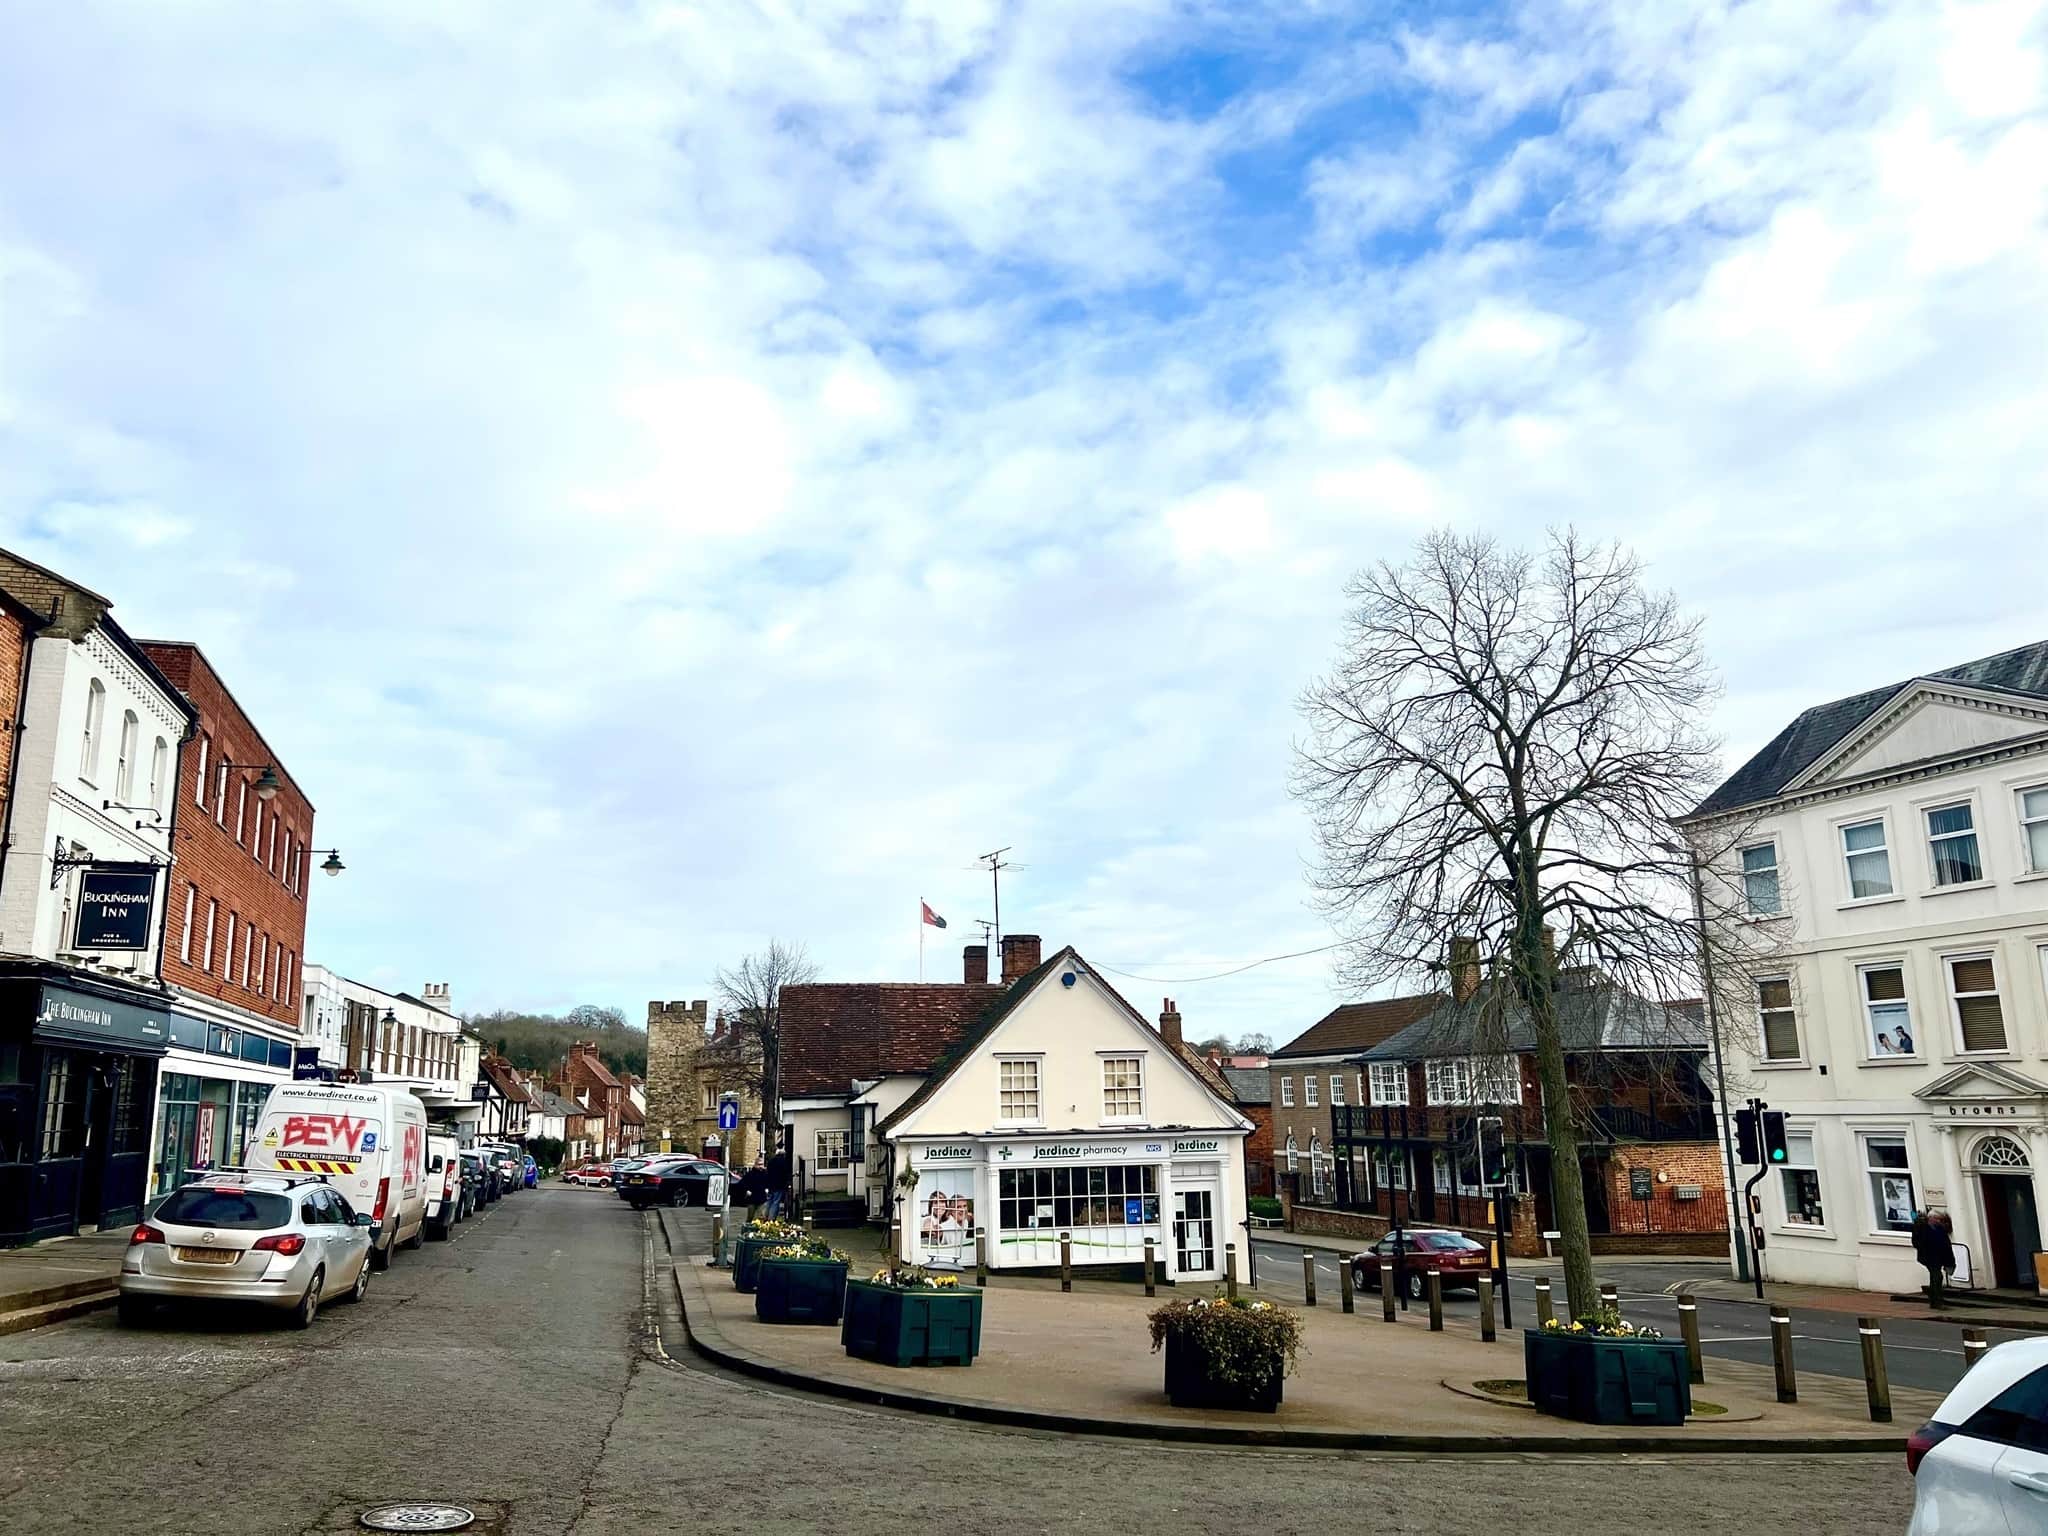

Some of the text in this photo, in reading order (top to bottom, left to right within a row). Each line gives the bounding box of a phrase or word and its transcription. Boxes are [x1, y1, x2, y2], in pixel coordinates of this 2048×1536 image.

[84, 891, 149, 904] BUCKINGHAM
[102, 905, 128, 918] INN
[61, 1002, 100, 1025] BUCKINGHAM
[282, 1088, 378, 1103] www.bewdirect.co.uk
[1949, 1105, 2017, 1116] browns
[283, 1108, 367, 1154] BEW
[924, 1146, 972, 1160] jardines
[1033, 1144, 1128, 1159] jardines pharmacy
[1173, 1140, 1218, 1153] jardines
